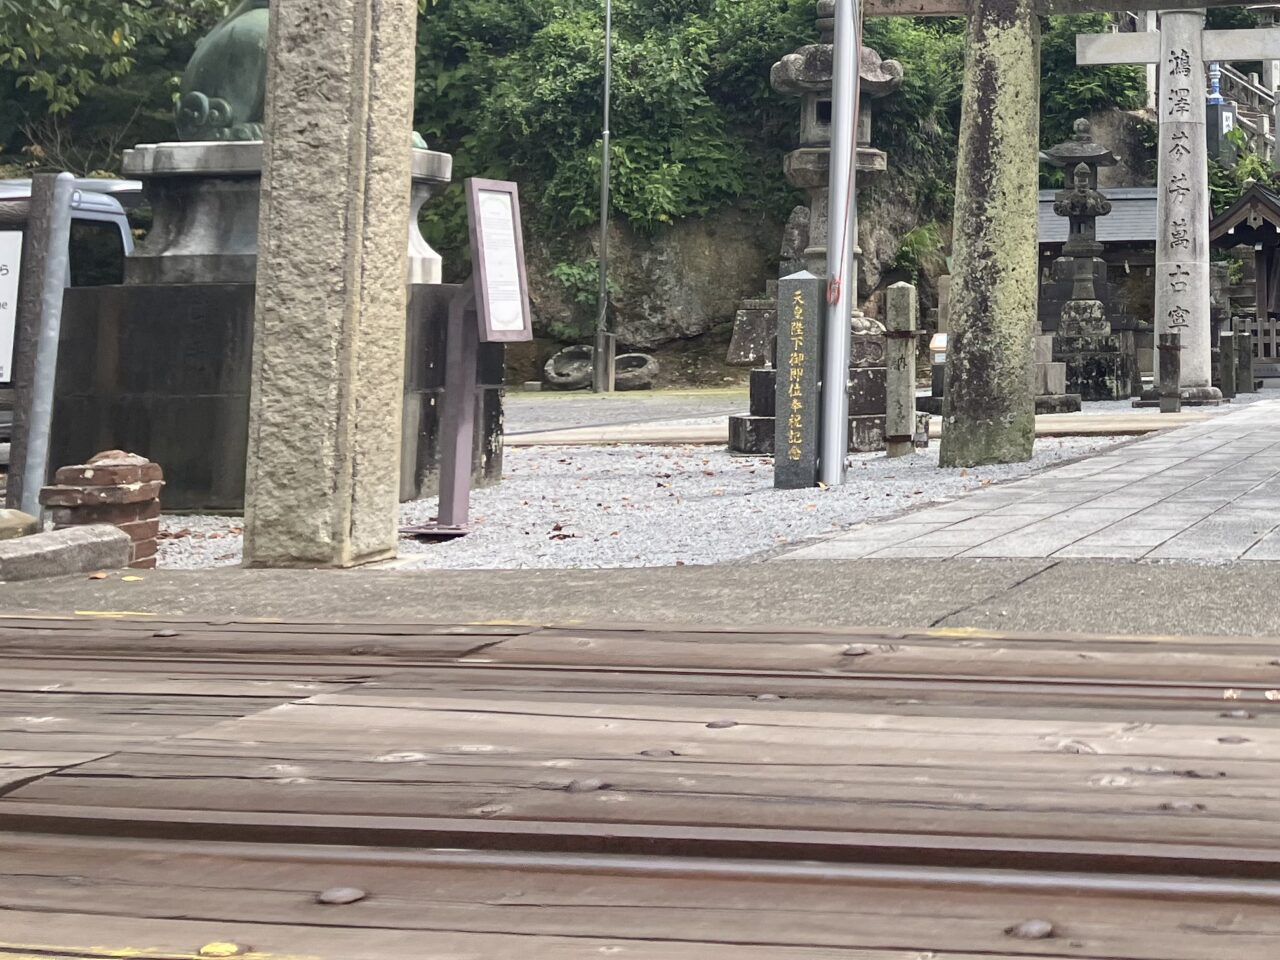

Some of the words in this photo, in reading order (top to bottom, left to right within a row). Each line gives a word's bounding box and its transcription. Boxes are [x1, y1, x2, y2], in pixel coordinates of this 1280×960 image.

[788, 290, 805, 461] 天皇陛下御即位奉祝記念
